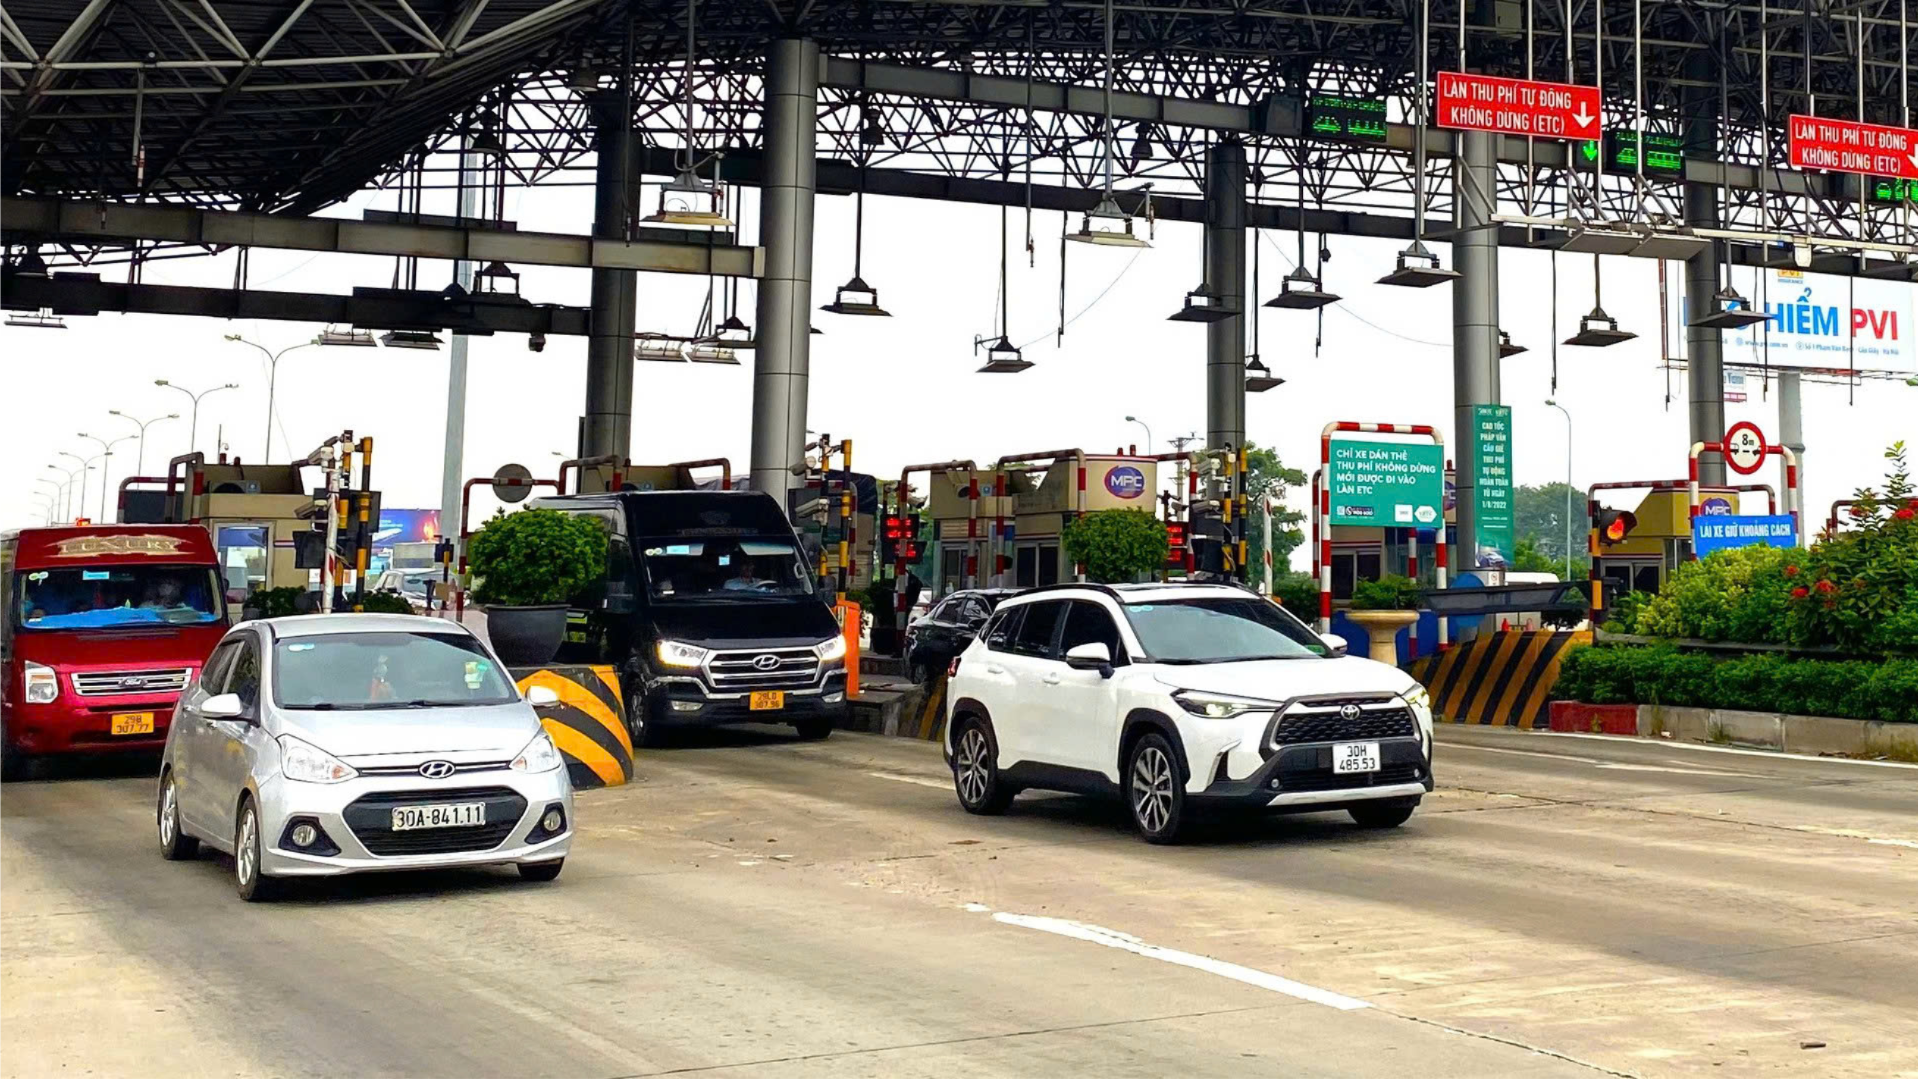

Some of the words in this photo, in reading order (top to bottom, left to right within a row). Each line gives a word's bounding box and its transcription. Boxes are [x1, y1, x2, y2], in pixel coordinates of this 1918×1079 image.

[1443, 78, 1467, 99] LÀN
[1471, 82, 1494, 101] THU
[1497, 83, 1518, 104] PHÍ
[1521, 88, 1536, 108] TỰ
[1539, 89, 1572, 110] ĐỘNG
[1451, 105, 1493, 127] KHÔNG
[1496, 109, 1529, 130] DỪNG
[1533, 114, 1565, 134] (ETC)
[1795, 120, 1816, 140] LÀN
[1818, 125, 1839, 143] THU
[1842, 126, 1860, 145] PHÍ
[1802, 146, 1838, 166] KHÔNG
[1841, 149, 1871, 170] DỪNG
[1874, 155, 1900, 174] (ETC)
[1765, 287, 1839, 336] HIỂM
[1851, 308, 1898, 340] PVI
[1336, 447, 1353, 459] CHỈ
[1355, 450, 1367, 459] XE
[1369, 449, 1389, 460] DÁN
[1390, 450, 1408, 461] THẺ
[1336, 461, 1355, 470] THU
[1357, 460, 1373, 471] PHÍ
[1375, 461, 1408, 472] KHÔNG
[1410, 462, 1436, 474] DỪNG
[1111, 475, 1142, 487] MPC
[1336, 471, 1355, 482] MỚI
[1357, 473, 1383, 485] ĐƯỢC
[1397, 474, 1416, 485] VÀO
[1336, 483, 1355, 494] LÀN
[1356, 485, 1373, 495] ETC
[1705, 505, 1731, 516] MPC
[1700, 522, 1713, 538] LÁI
[1714, 525, 1724, 538] XE
[1739, 520, 1769, 537] KHOẢNG
[1770, 521, 1791, 536] CÁCH
[61, 539, 178, 553] LUXURY
[1347, 745, 1367, 757] 30H
[1339, 757, 1376, 771] 485.53
[397, 805, 480, 827] 30A-841.11
